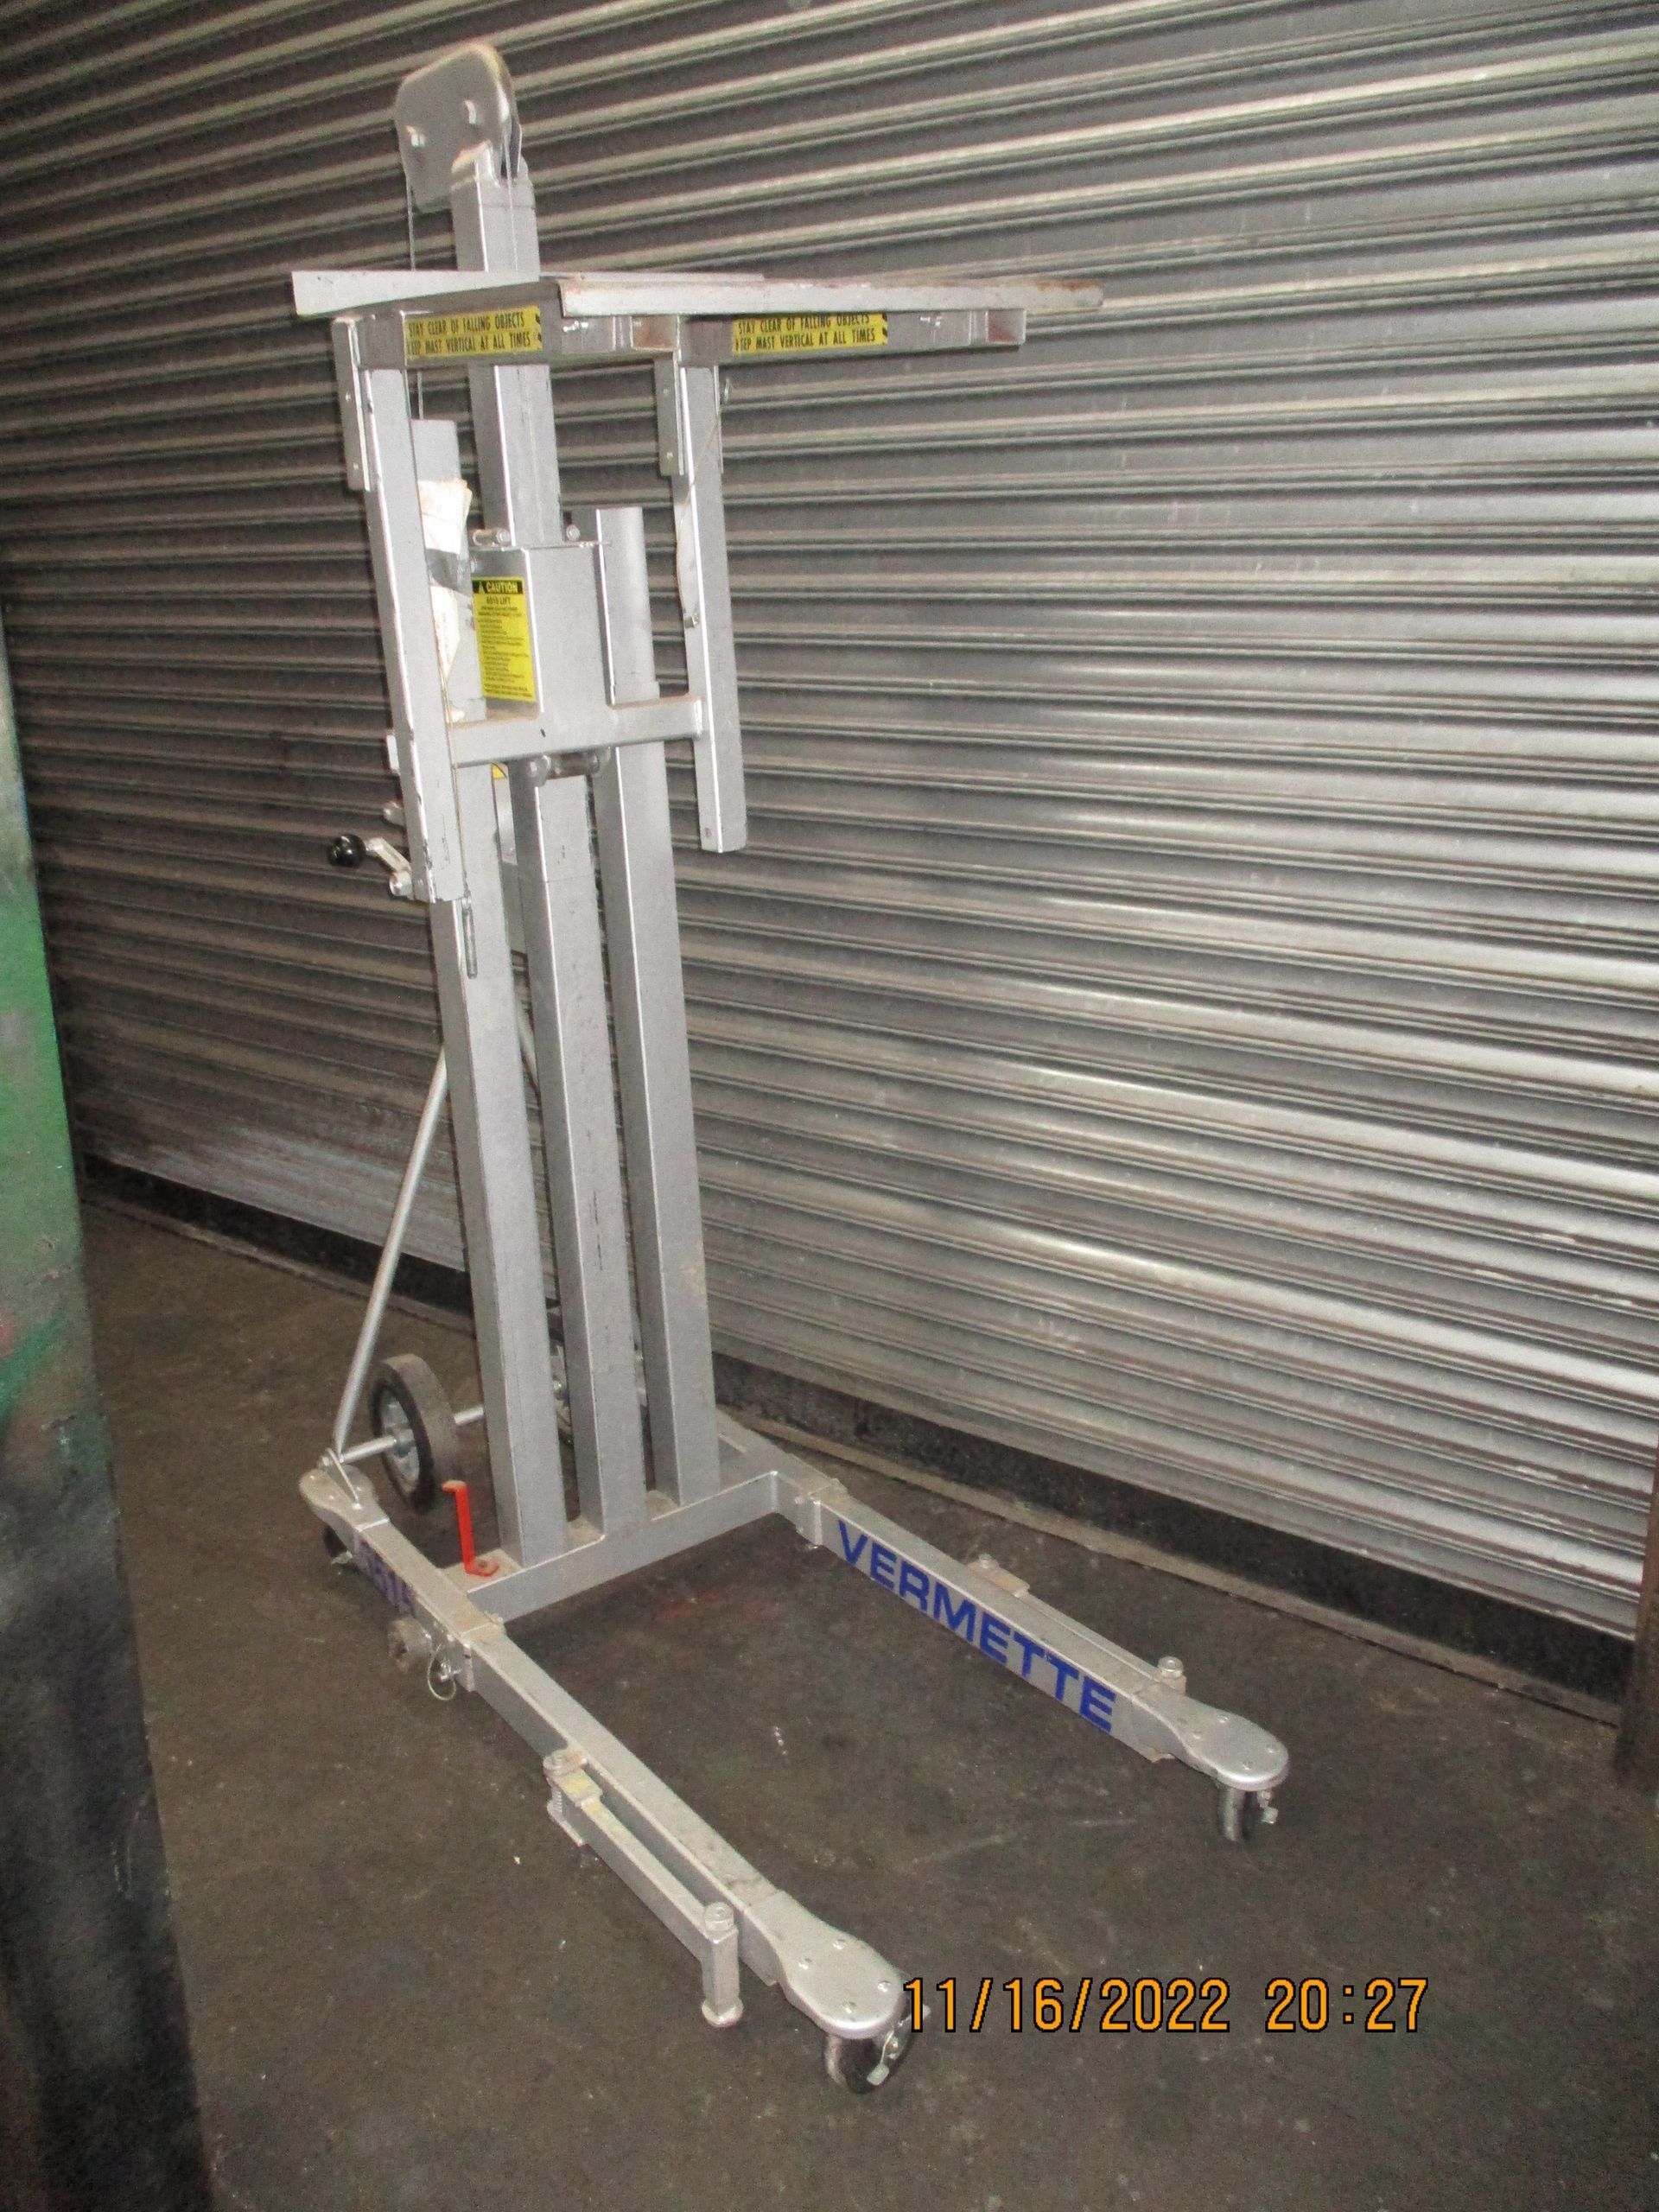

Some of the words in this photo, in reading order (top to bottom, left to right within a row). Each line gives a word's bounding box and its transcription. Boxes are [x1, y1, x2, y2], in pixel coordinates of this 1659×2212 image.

[409, 322, 423, 337] STAY
[428, 319, 447, 335] CLEAR
[451, 318, 459, 334] OF
[462, 315, 491, 332] FALLING
[494, 312, 524, 330] OBJECTS
[738, 321, 755, 334] STAY
[760, 319, 781, 334] CLEAR
[786, 318, 796, 331] OF
[800, 315, 831, 329] FALLING
[836, 313, 870, 327] OBJECTS
[425, 338, 442, 354] MAST
[445, 335, 475, 353] VERTICAL
[480, 334, 488, 350] AT
[493, 333, 505, 349] ALL
[510, 331, 531, 347] TIMES
[756, 335, 775, 350] MAST
[779, 333, 814, 348] VERTICAL
[818, 332, 828, 346] AT
[833, 330, 847, 345] ALL
[852, 327, 875, 344] TIMES
[486, 581, 518, 594] CAUTION
[838, 1519, 1116, 1733] VERMETTE
